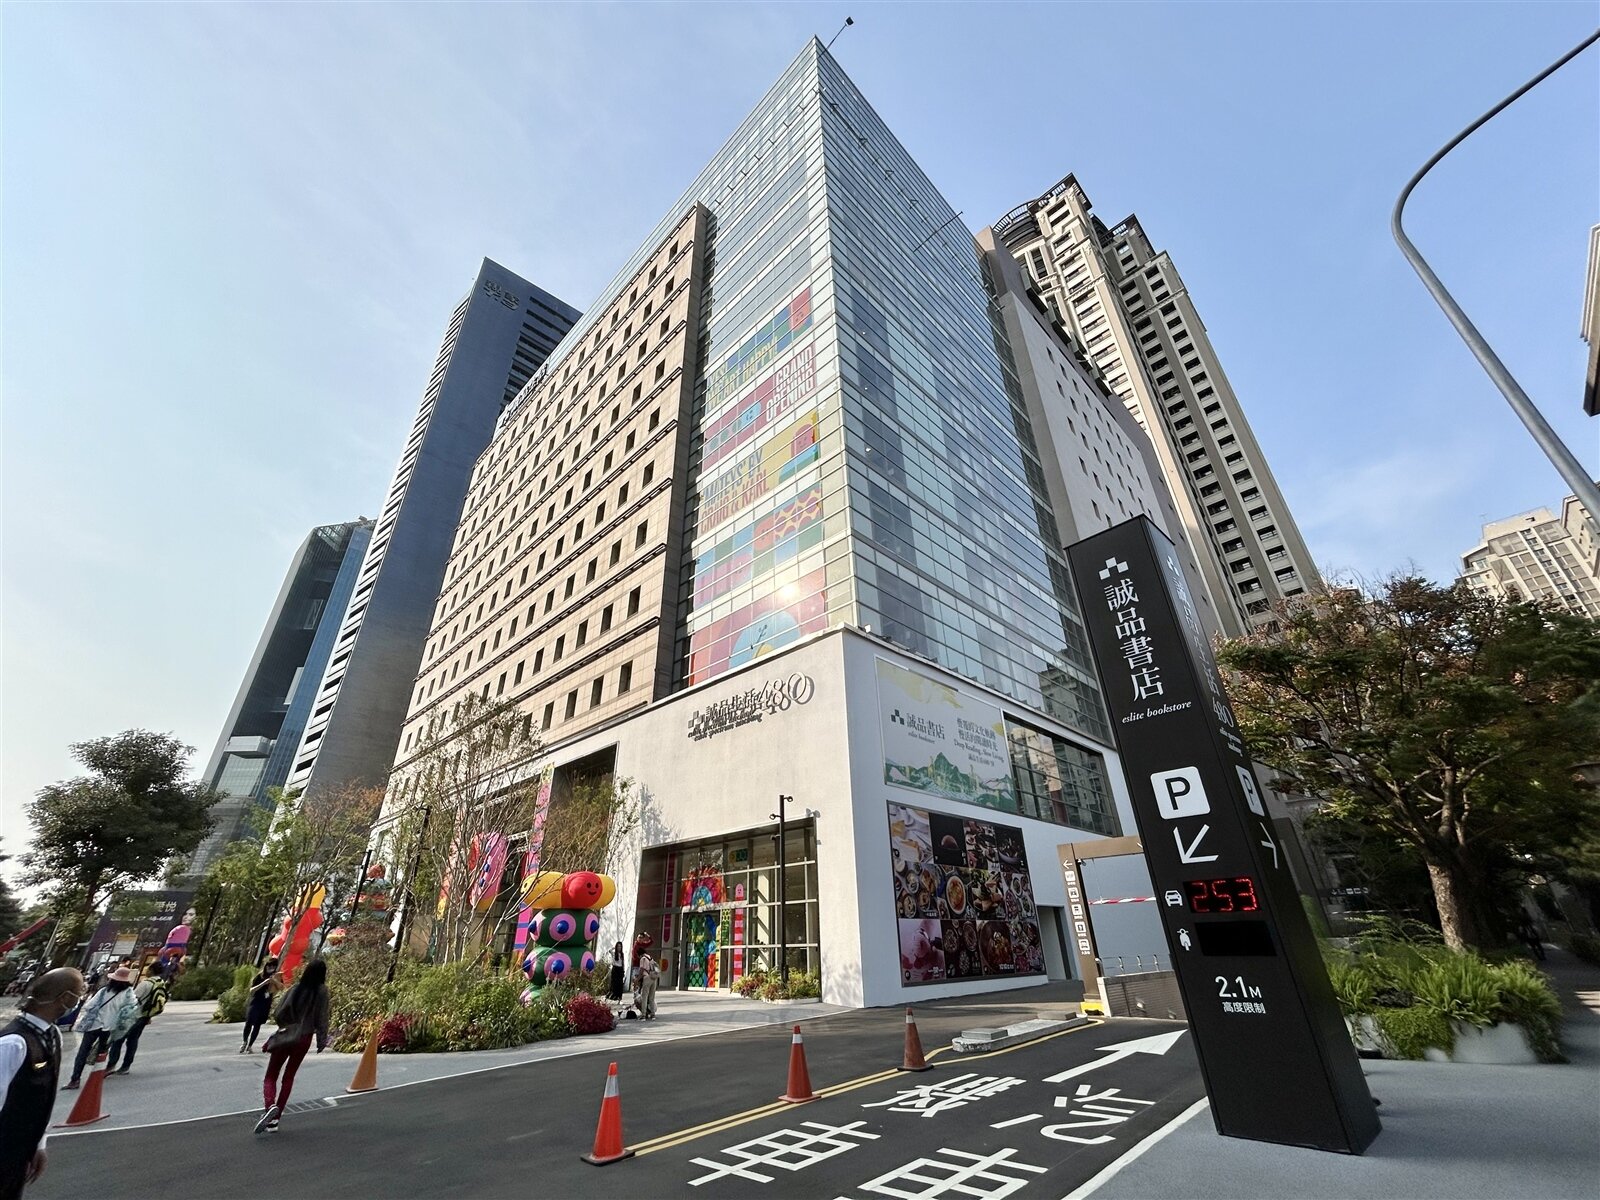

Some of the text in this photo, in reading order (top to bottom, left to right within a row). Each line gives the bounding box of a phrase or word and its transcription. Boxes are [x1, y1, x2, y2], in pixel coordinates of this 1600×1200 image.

[776, 346, 813, 393] GRAND
[766, 367, 814, 422] OPENING
[749, 448, 763, 479] BY
[742, 469, 769, 508] KARL
[1104, 578, 1165, 702] 誠品書店
[757, 671, 809, 712] 480
[906, 713, 945, 740] 誠品書店
[1122, 700, 1192, 724] eslite bookstore
[1164, 776, 1191, 811] P
[1241, 774, 1255, 807] P
[1190, 878, 1259, 913] 253
[1215, 975, 1263, 998] 2.1M
[1222, 1001, 1267, 1015] 高度限制
